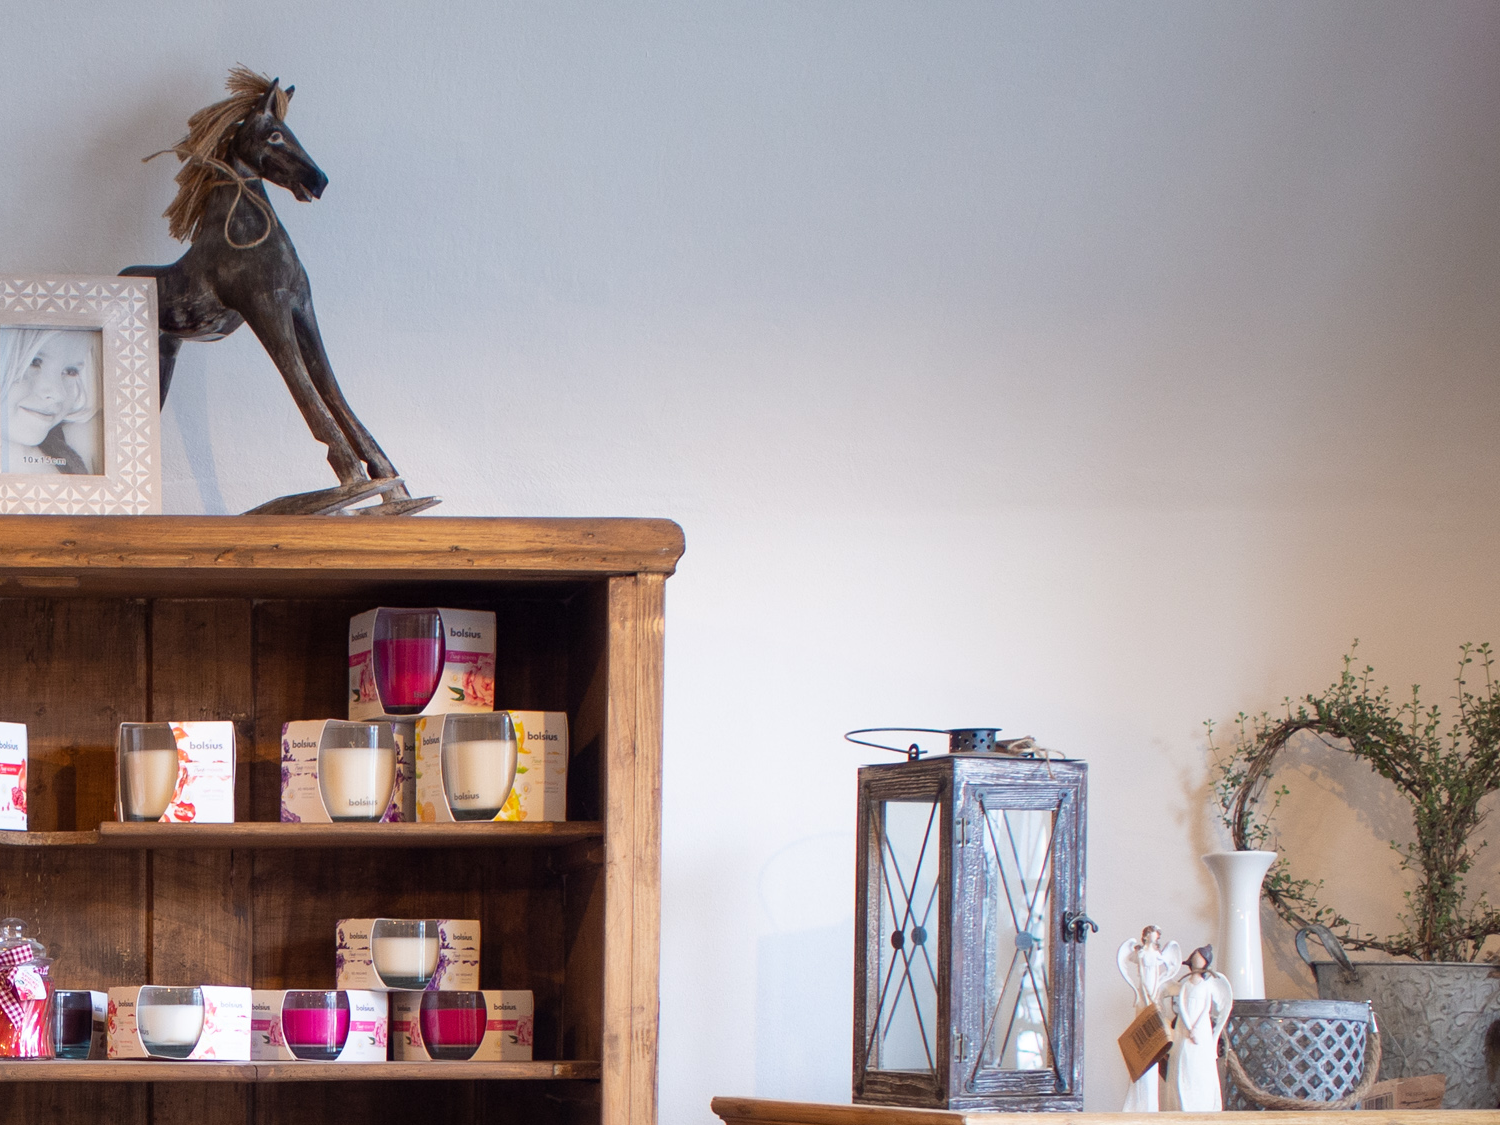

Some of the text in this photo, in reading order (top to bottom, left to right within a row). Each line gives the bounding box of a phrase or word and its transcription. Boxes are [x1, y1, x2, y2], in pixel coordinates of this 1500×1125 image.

[22, 455, 67, 466] 10x15cm
[451, 628, 481, 639] bolsius
[423, 735, 440, 746] bolsius
[528, 730, 558, 741] bolsius
[0, 740, 18, 750] bolsius
[190, 740, 223, 749] bolsius
[292, 738, 316, 748] bolsius
[454, 791, 479, 800] bolsius
[349, 798, 378, 806] bolsius
[349, 931, 367, 940] bolsius
[453, 933, 472, 941] bolsius
